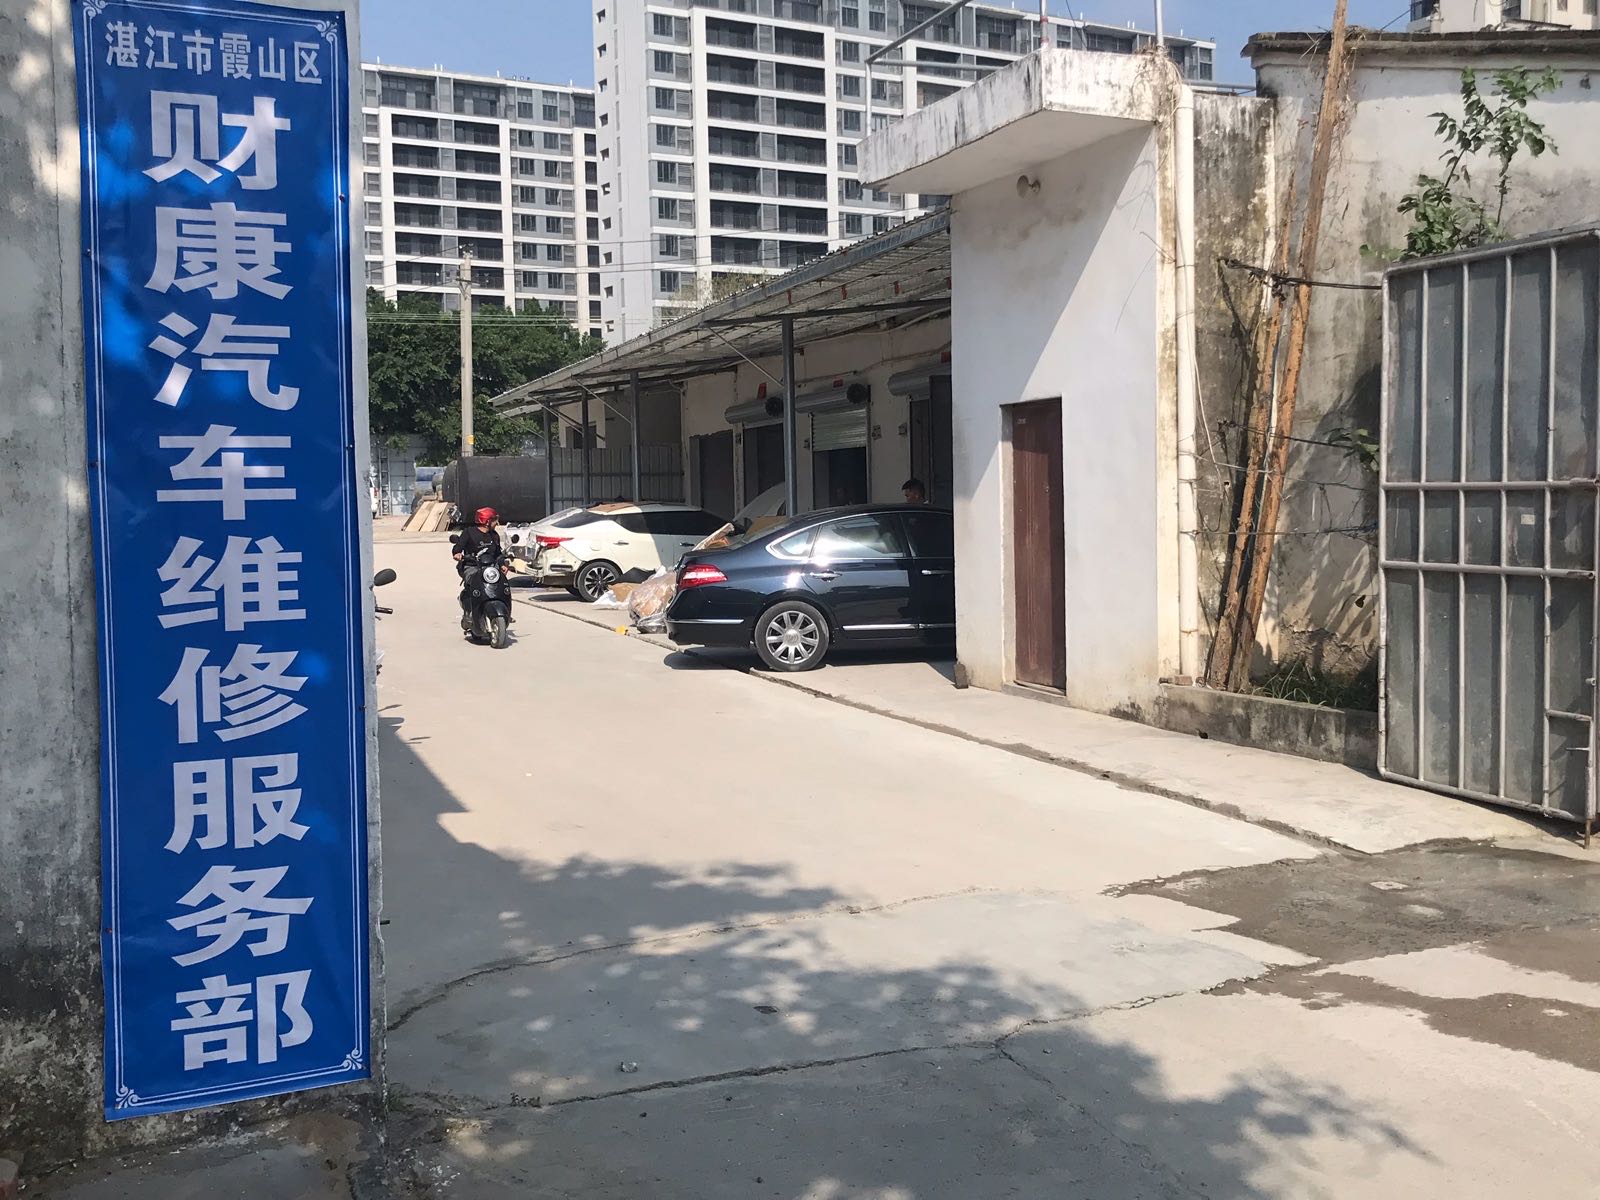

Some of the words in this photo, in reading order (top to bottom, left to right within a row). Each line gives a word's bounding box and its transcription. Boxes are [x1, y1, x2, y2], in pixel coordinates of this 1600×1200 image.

[105, 20, 323, 84] 湛江市霞山区
[143, 90, 314, 1071] 财康汽车维修服务部
